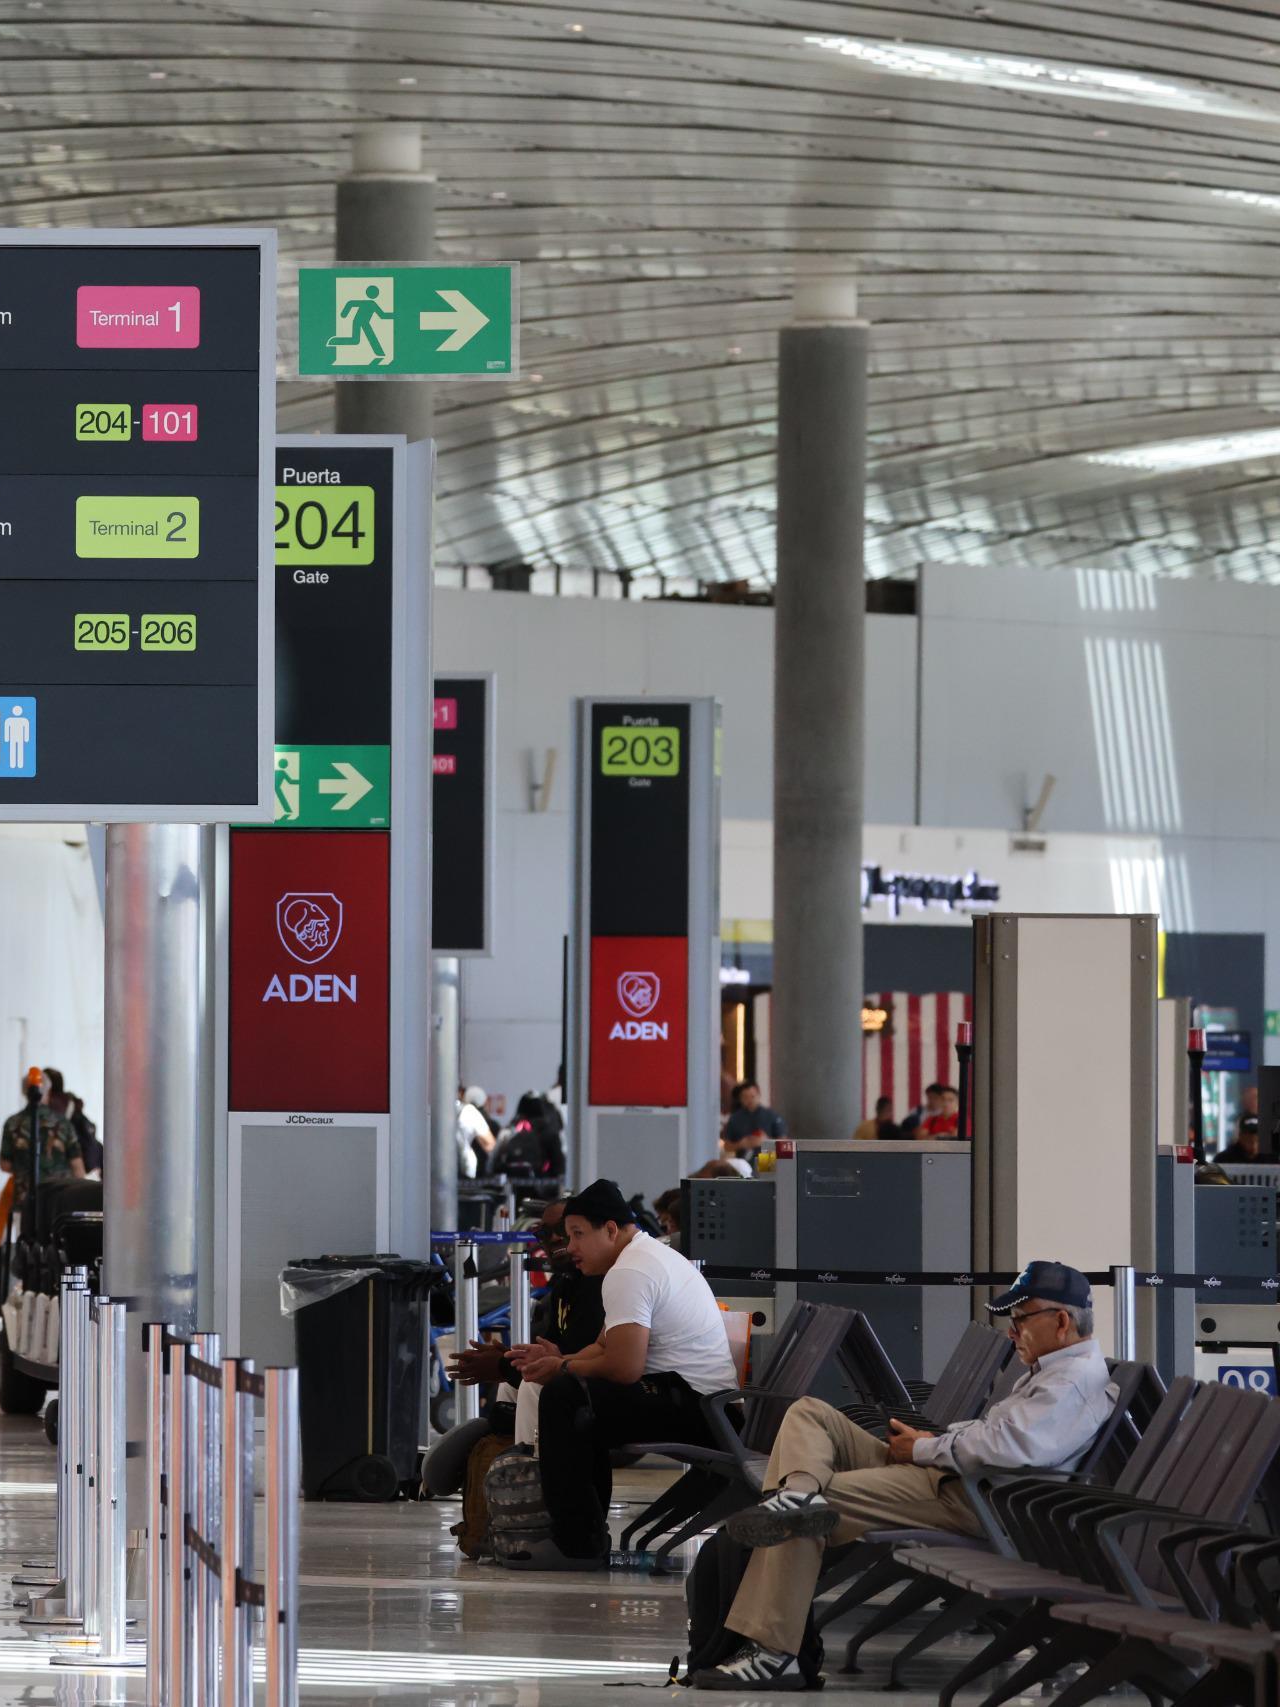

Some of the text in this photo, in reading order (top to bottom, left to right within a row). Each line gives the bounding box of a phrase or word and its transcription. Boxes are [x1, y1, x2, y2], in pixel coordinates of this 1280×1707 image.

[88, 301, 181, 333] Terminal 1
[79, 410, 128, 435] 204
[148, 411, 191, 435] 101
[283, 467, 341, 484] Puerta
[88, 511, 187, 543] Terminal 2
[293, 569, 330, 584] Gate
[77, 620, 127, 644] 205
[144, 620, 193, 645] 206
[607, 735, 674, 767] 203
[261, 973, 357, 1003] ADEN
[608, 1021, 669, 1041] ADEN
[285, 1115, 335, 1125] JCDecaux
